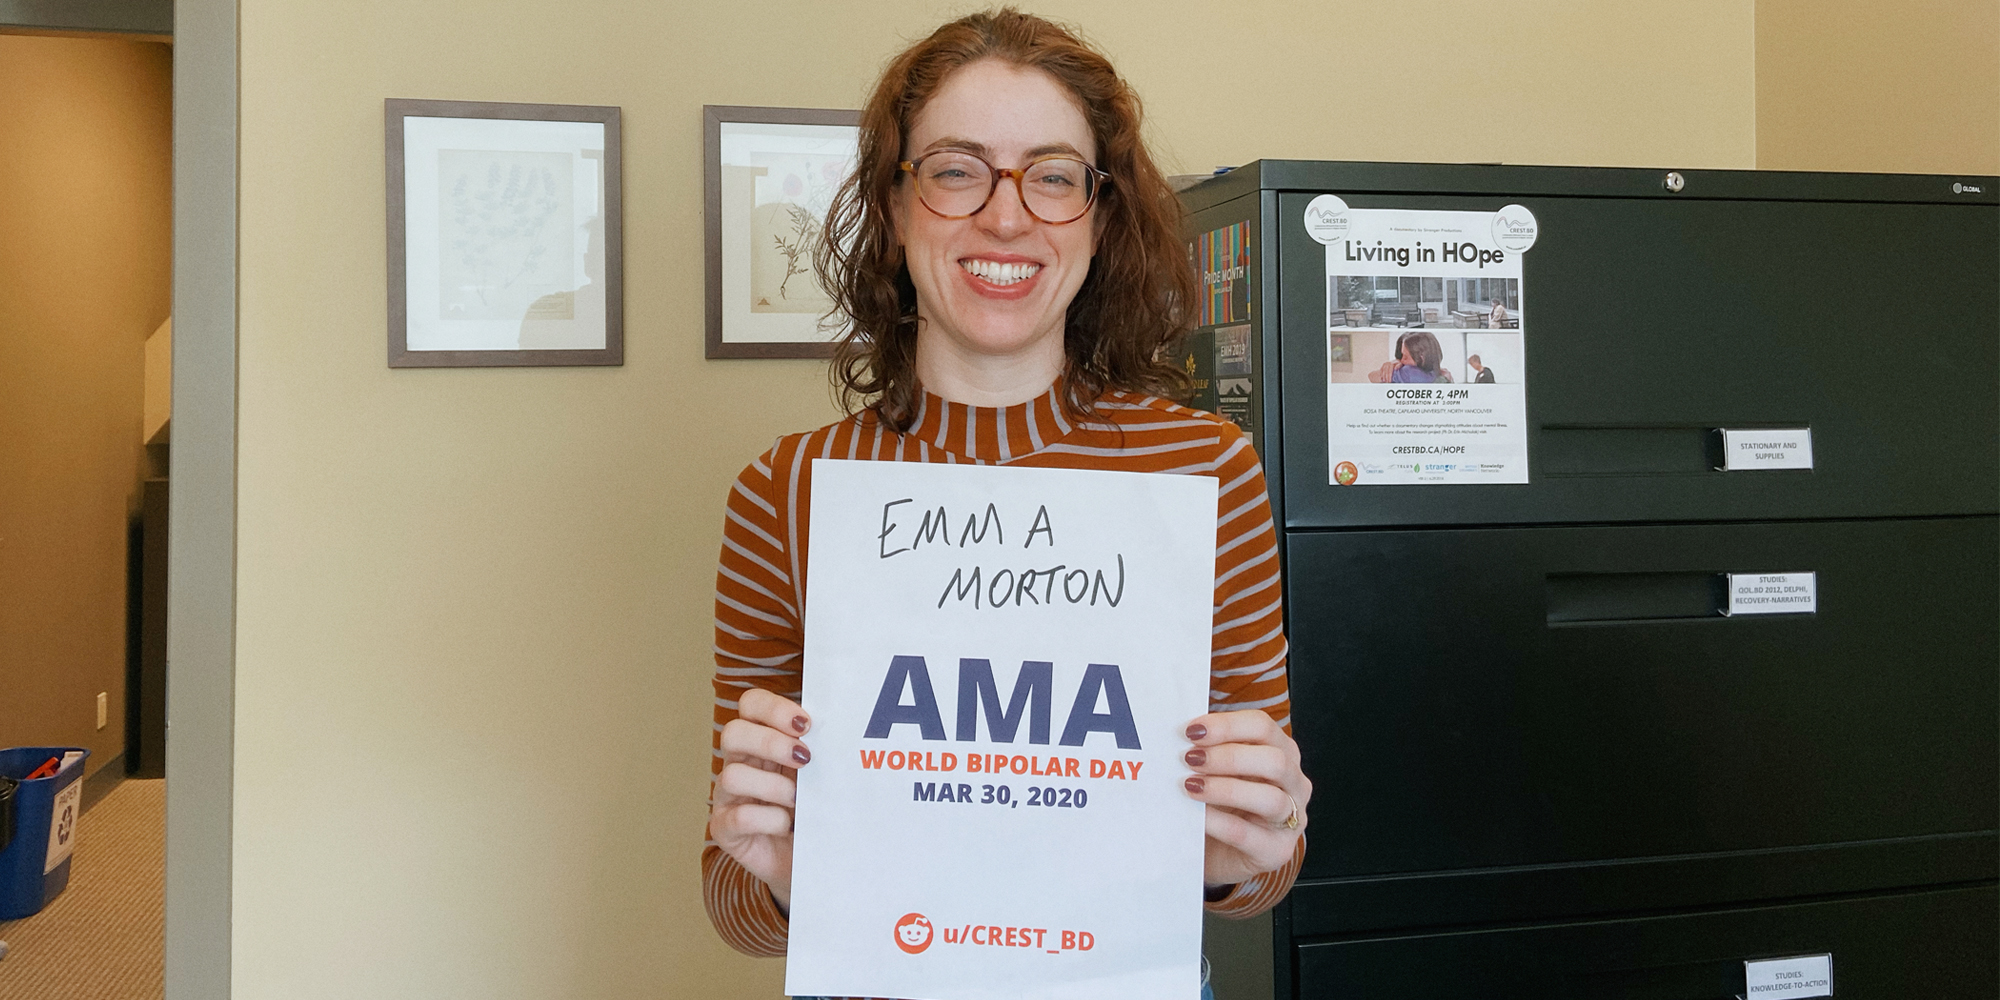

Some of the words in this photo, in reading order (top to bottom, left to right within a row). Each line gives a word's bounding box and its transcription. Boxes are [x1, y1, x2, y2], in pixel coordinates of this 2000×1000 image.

[1346, 241, 1409, 267] Living
[1416, 241, 1435, 262] in
[1443, 242, 1504, 268] HOpe
[1204, 270, 1220, 285] PRIDE
[1222, 265, 1244, 281] MONTH
[1386, 389, 1432, 398] OCTOBER
[1436, 390, 1444, 400] 2,
[1447, 390, 1468, 398] 4PM
[1392, 446, 1465, 455] CRESTBD.CA/HOPE
[878, 498, 1054, 559] EMMA
[938, 554, 1125, 610] MORTON
[1735, 596, 1811, 604] RECOVERY-NARRATIVES
[863, 654, 1142, 750] AMA
[860, 750, 958, 772] WORLD
[966, 754, 1081, 778] BIPOLAR
[1089, 758, 1144, 782] DAY
[913, 782, 974, 804] MAR
[981, 784, 1018, 808] 30,
[1027, 786, 1088, 809] 2020
[943, 924, 1095, 954] u/CREST_BD
[1750, 980, 1828, 992] KNOWLEDGE-TO-ACTION
[1775, 971, 1804, 980] STUDIES:
